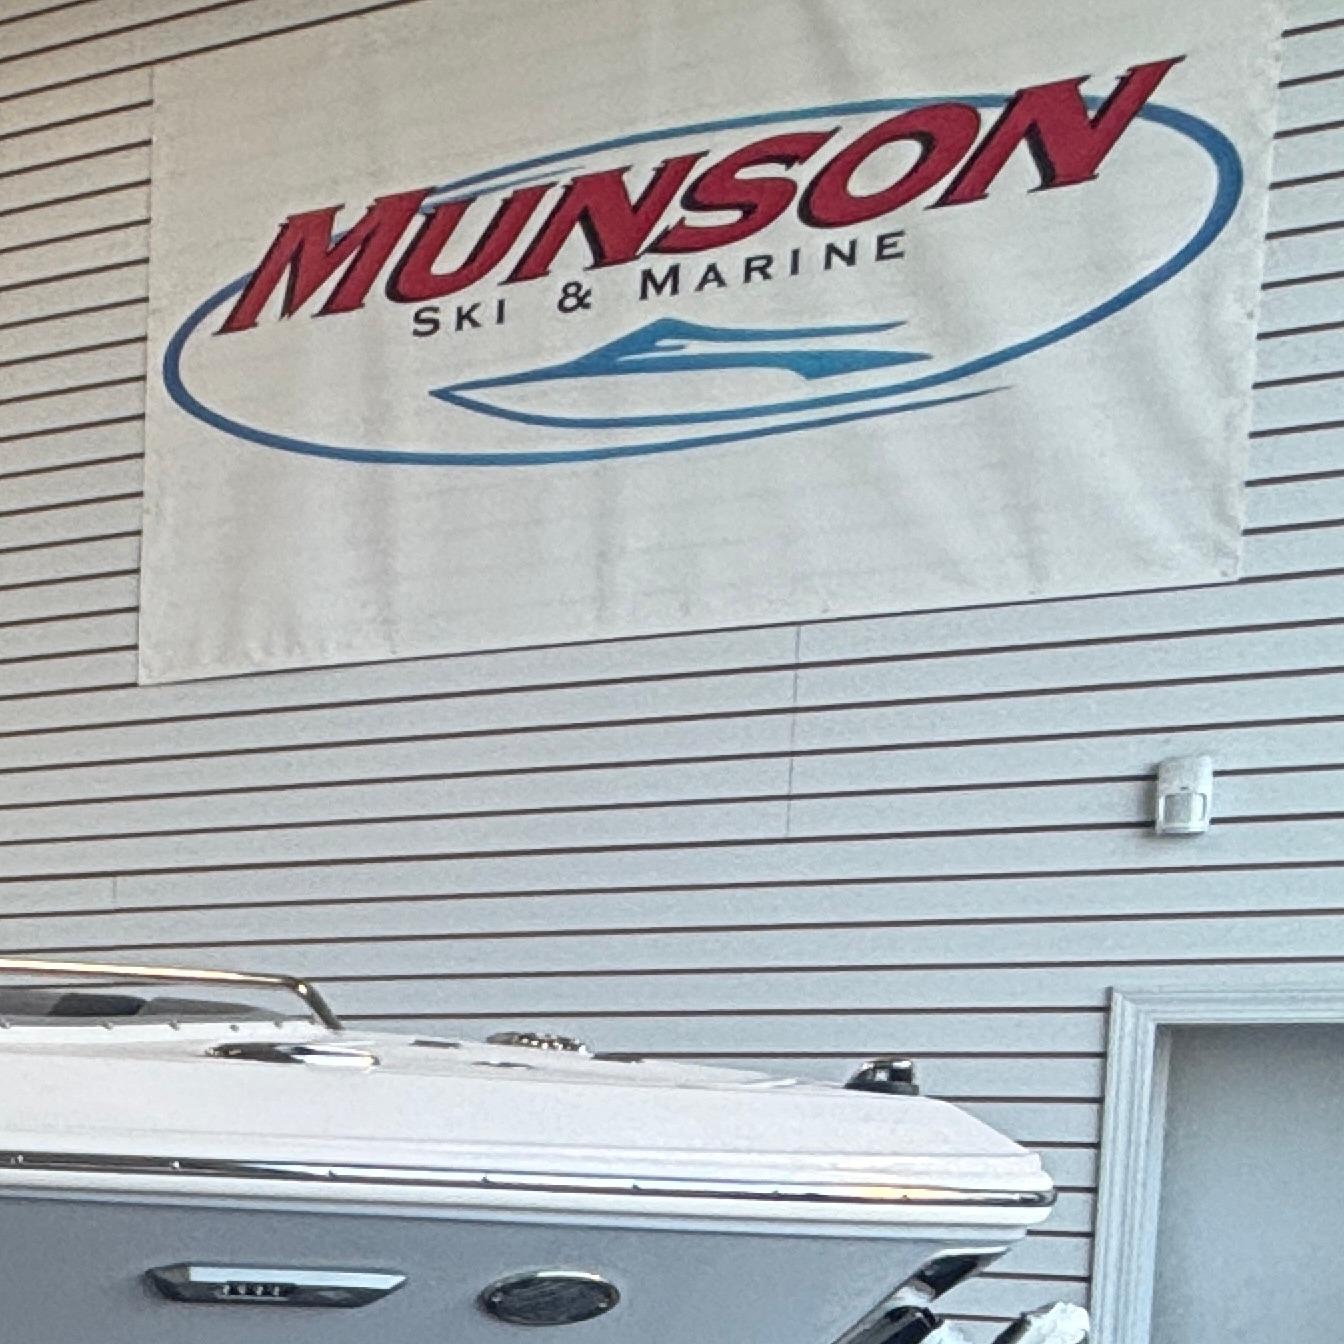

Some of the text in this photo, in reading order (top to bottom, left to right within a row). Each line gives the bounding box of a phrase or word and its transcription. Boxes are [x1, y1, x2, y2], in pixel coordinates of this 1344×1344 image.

[214, 55, 1185, 336] MUNSON
[412, 229, 907, 338] SKI & MARINE
